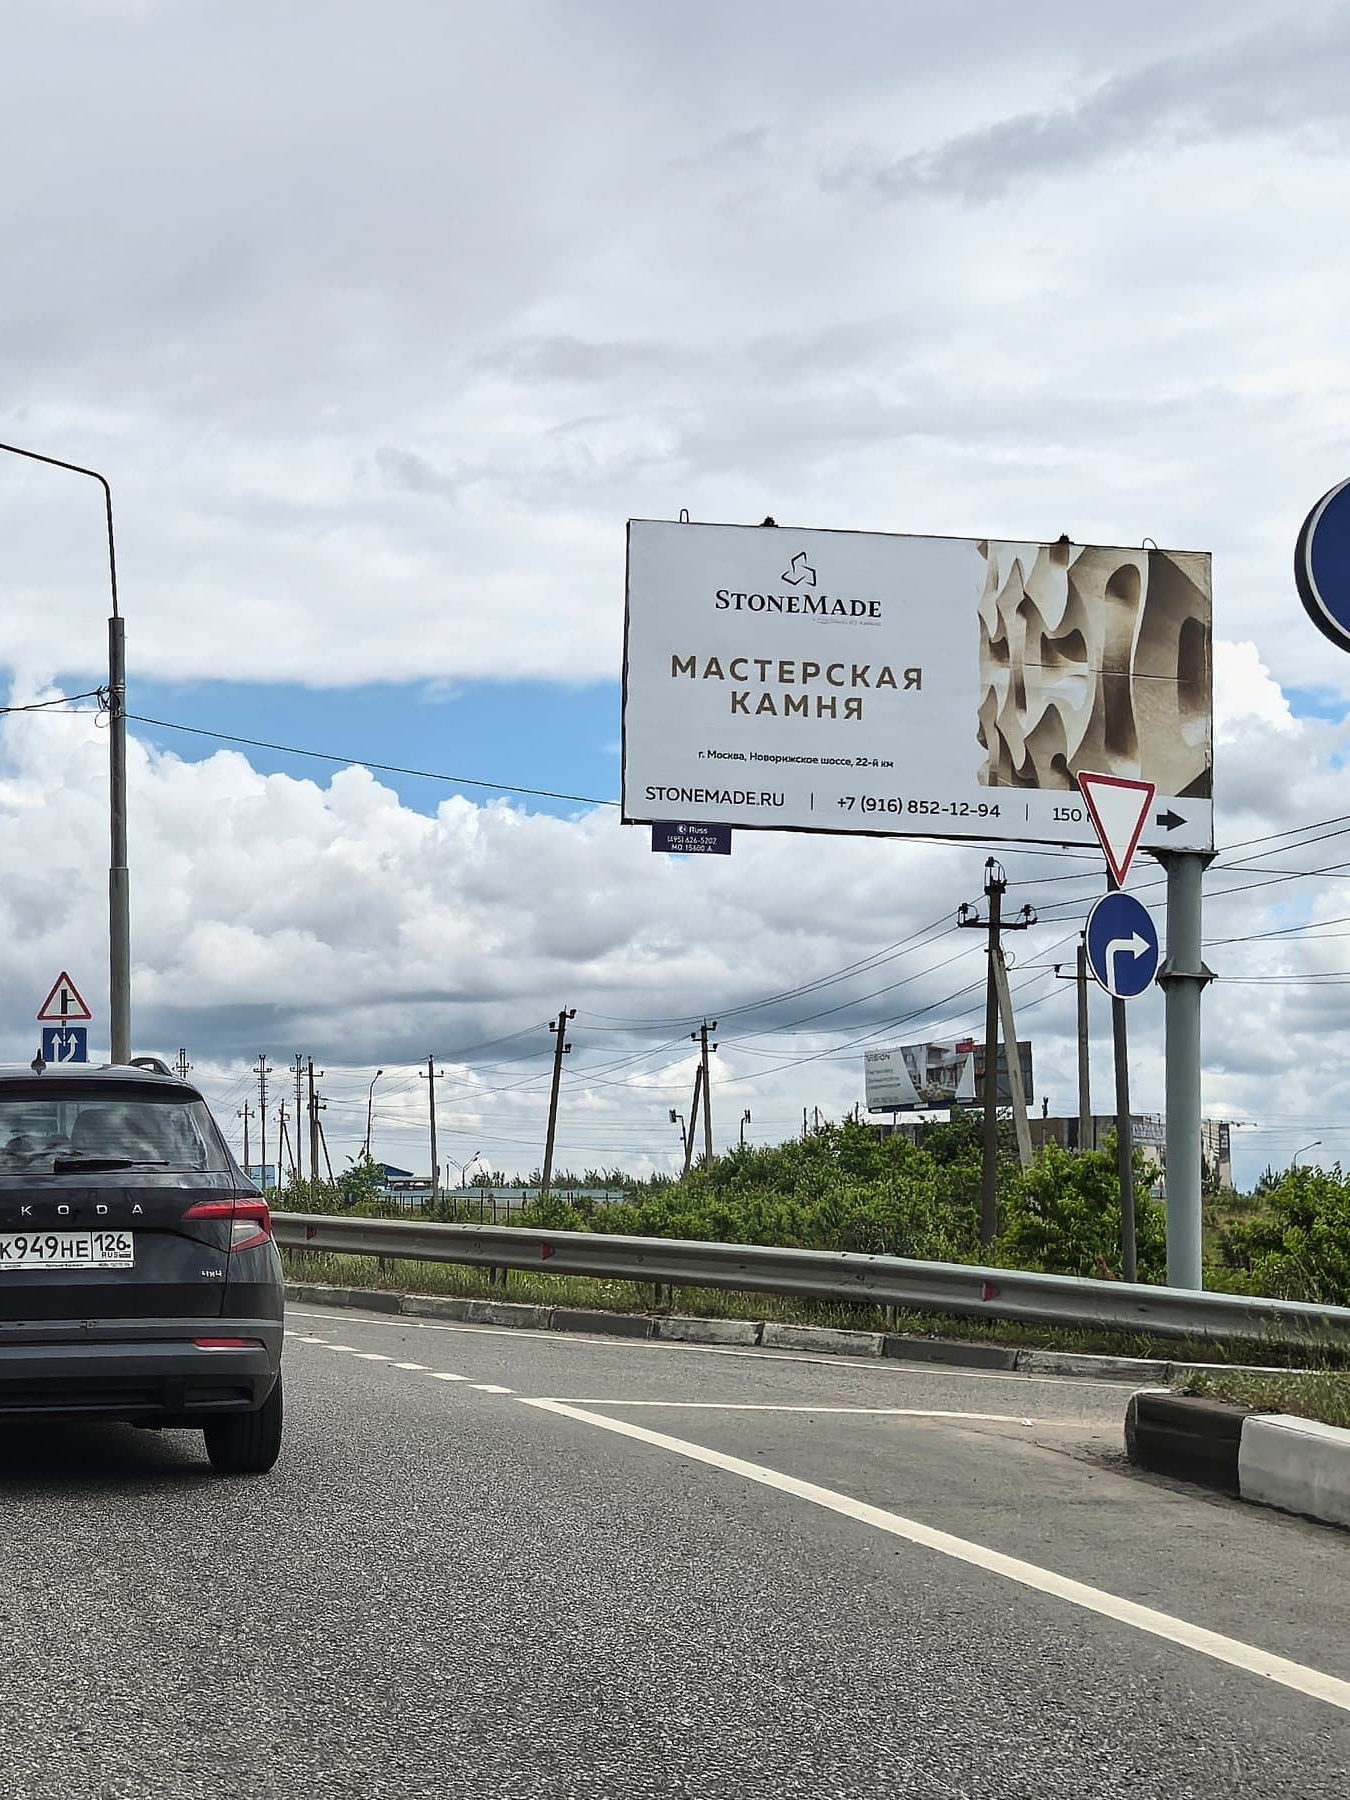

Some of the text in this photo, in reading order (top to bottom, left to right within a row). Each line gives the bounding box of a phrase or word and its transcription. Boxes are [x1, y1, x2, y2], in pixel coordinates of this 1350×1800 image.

[671, 654, 923, 691] МАСТЕРСКАЯ
[731, 691, 863, 721] КАМНЯ
[707, 750, 747, 762] Москва,
[749, 752, 819, 765] Новорижское
[820, 757, 854, 768] шоссе,
[855, 757, 879, 768] 22-й
[645, 786, 786, 807] STONEMADE.RU
[837, 795, 1001, 818] +7 (916) 852-12-94
[1052, 807, 1083, 822] 150
[94, 1233, 126, 1252] 126
[101, 1251, 118, 1259] RUS
